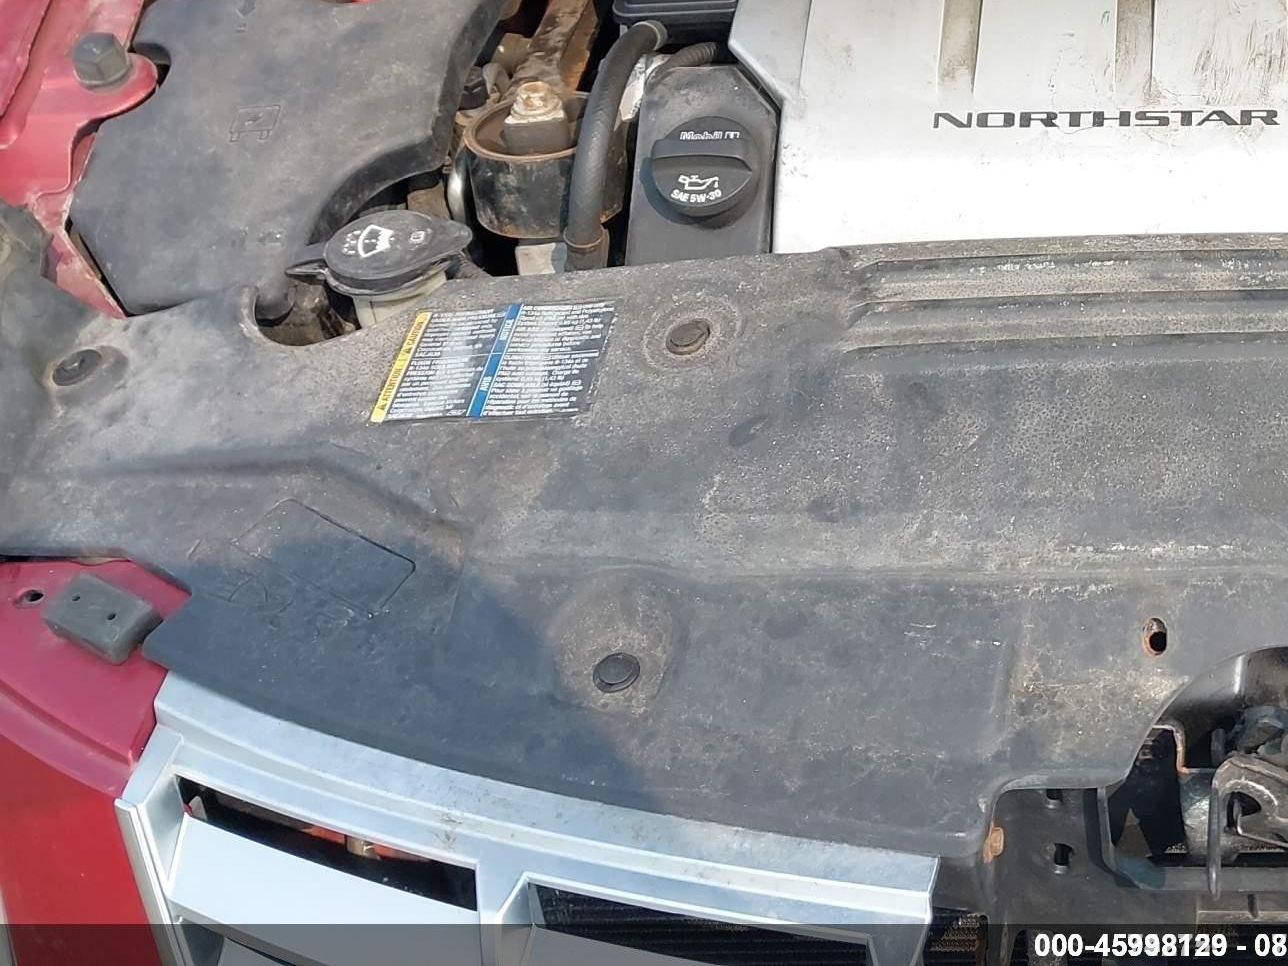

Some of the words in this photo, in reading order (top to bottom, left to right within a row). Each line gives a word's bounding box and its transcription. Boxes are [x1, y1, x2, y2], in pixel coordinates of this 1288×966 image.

[933, 109, 1279, 128] NORTHSTAR
[670, 189, 689, 203] SAE
[689, 189, 722, 203] 5W-30
[498, 318, 515, 341] NOTICE
